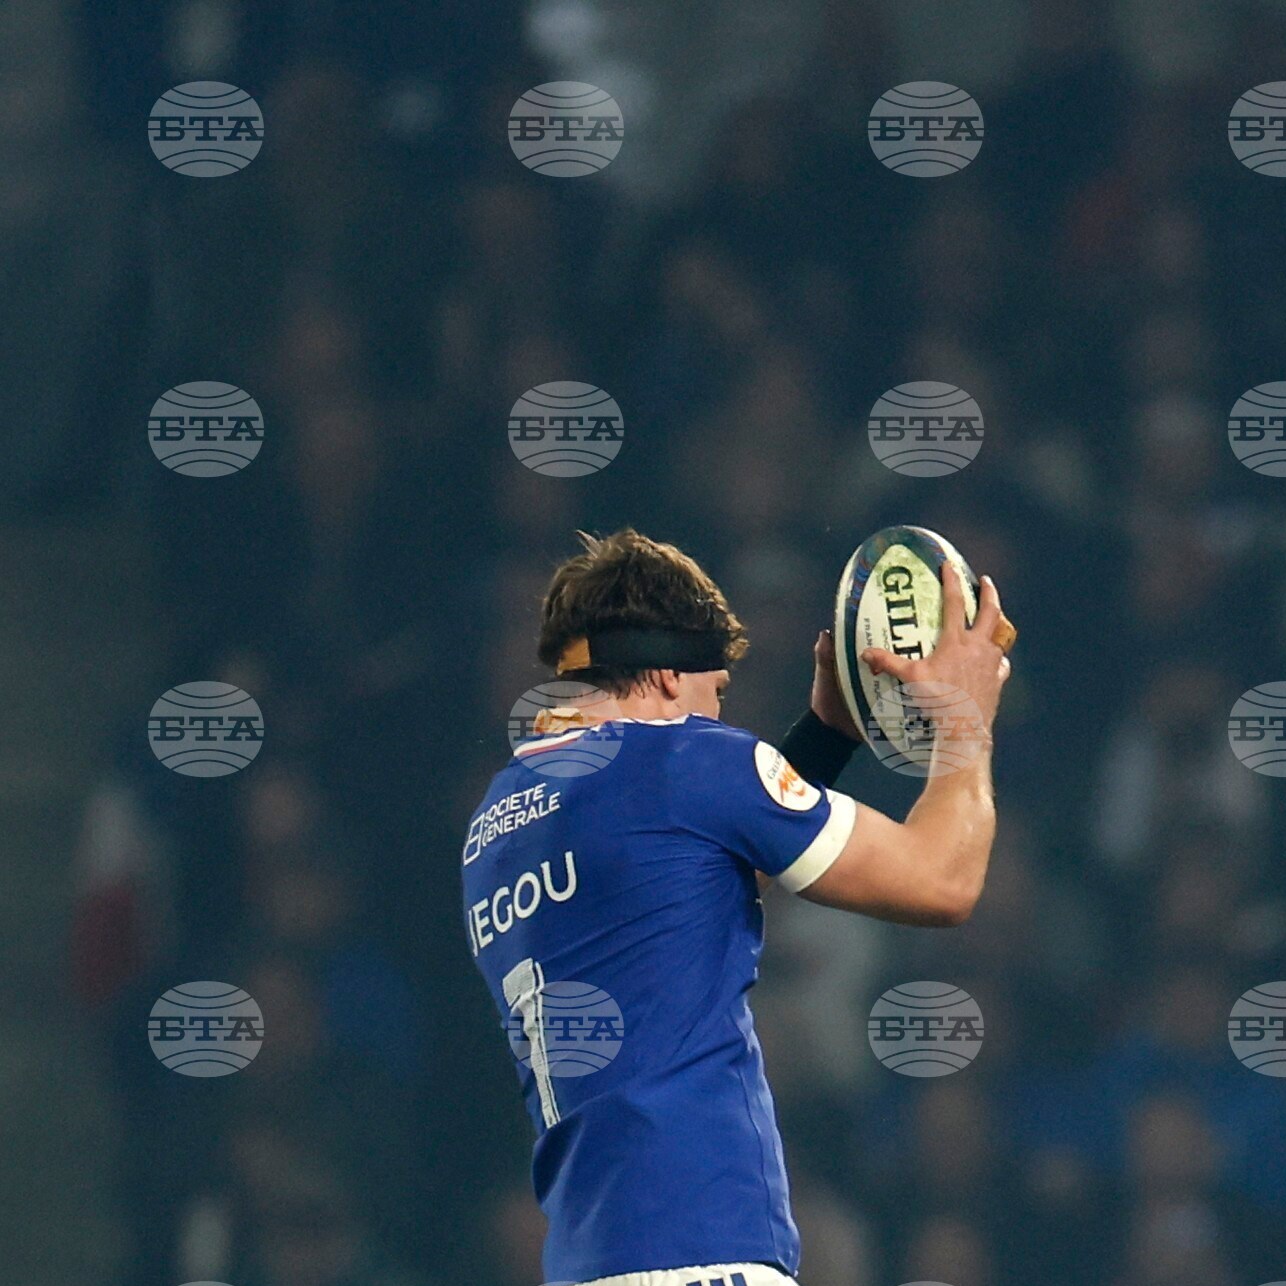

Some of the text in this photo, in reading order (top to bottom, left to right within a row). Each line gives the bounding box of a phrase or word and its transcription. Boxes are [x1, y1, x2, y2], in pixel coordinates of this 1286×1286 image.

[482, 792, 561, 846] GENERALE
[485, 783, 547, 822] SOCIETE
[467, 850, 577, 957] JEGOU
